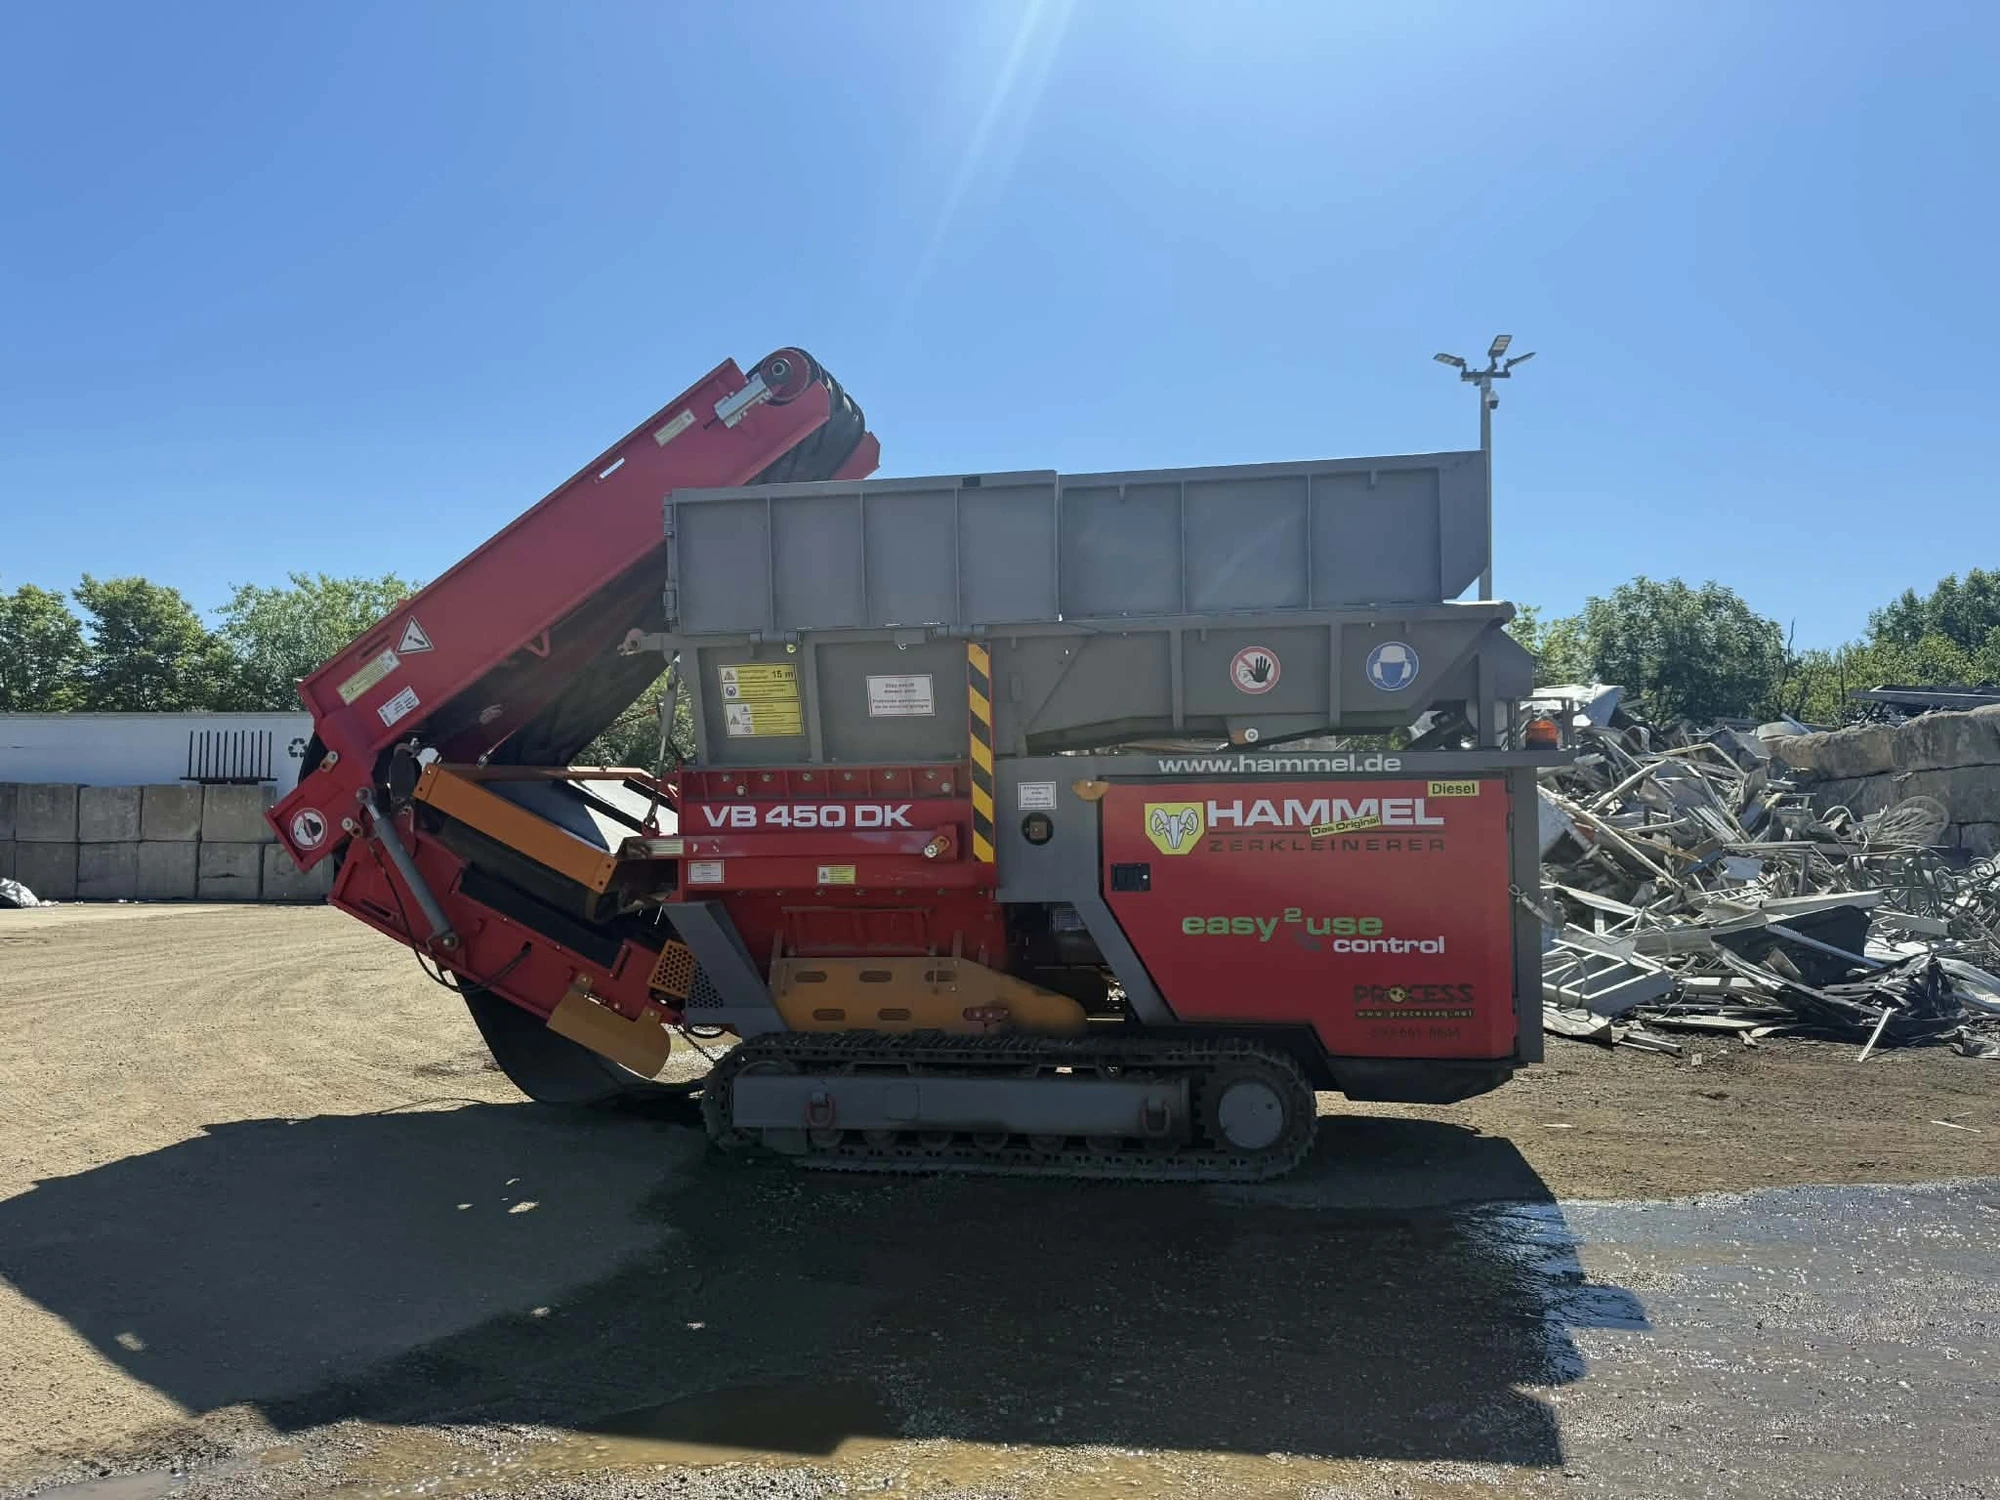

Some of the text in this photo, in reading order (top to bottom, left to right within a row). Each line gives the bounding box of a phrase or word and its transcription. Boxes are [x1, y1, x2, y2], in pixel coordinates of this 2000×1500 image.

[1158, 753, 1402, 774] www.hammel.de
[1432, 783, 1476, 795] Diesel
[702, 804, 914, 828] VB 450 DK
[1207, 798, 1446, 827] HAMMEL
[1311, 817, 1380, 836] Das Original
[1208, 837, 1446, 853] ZERKLEINERER
[1333, 935, 1446, 955] control
